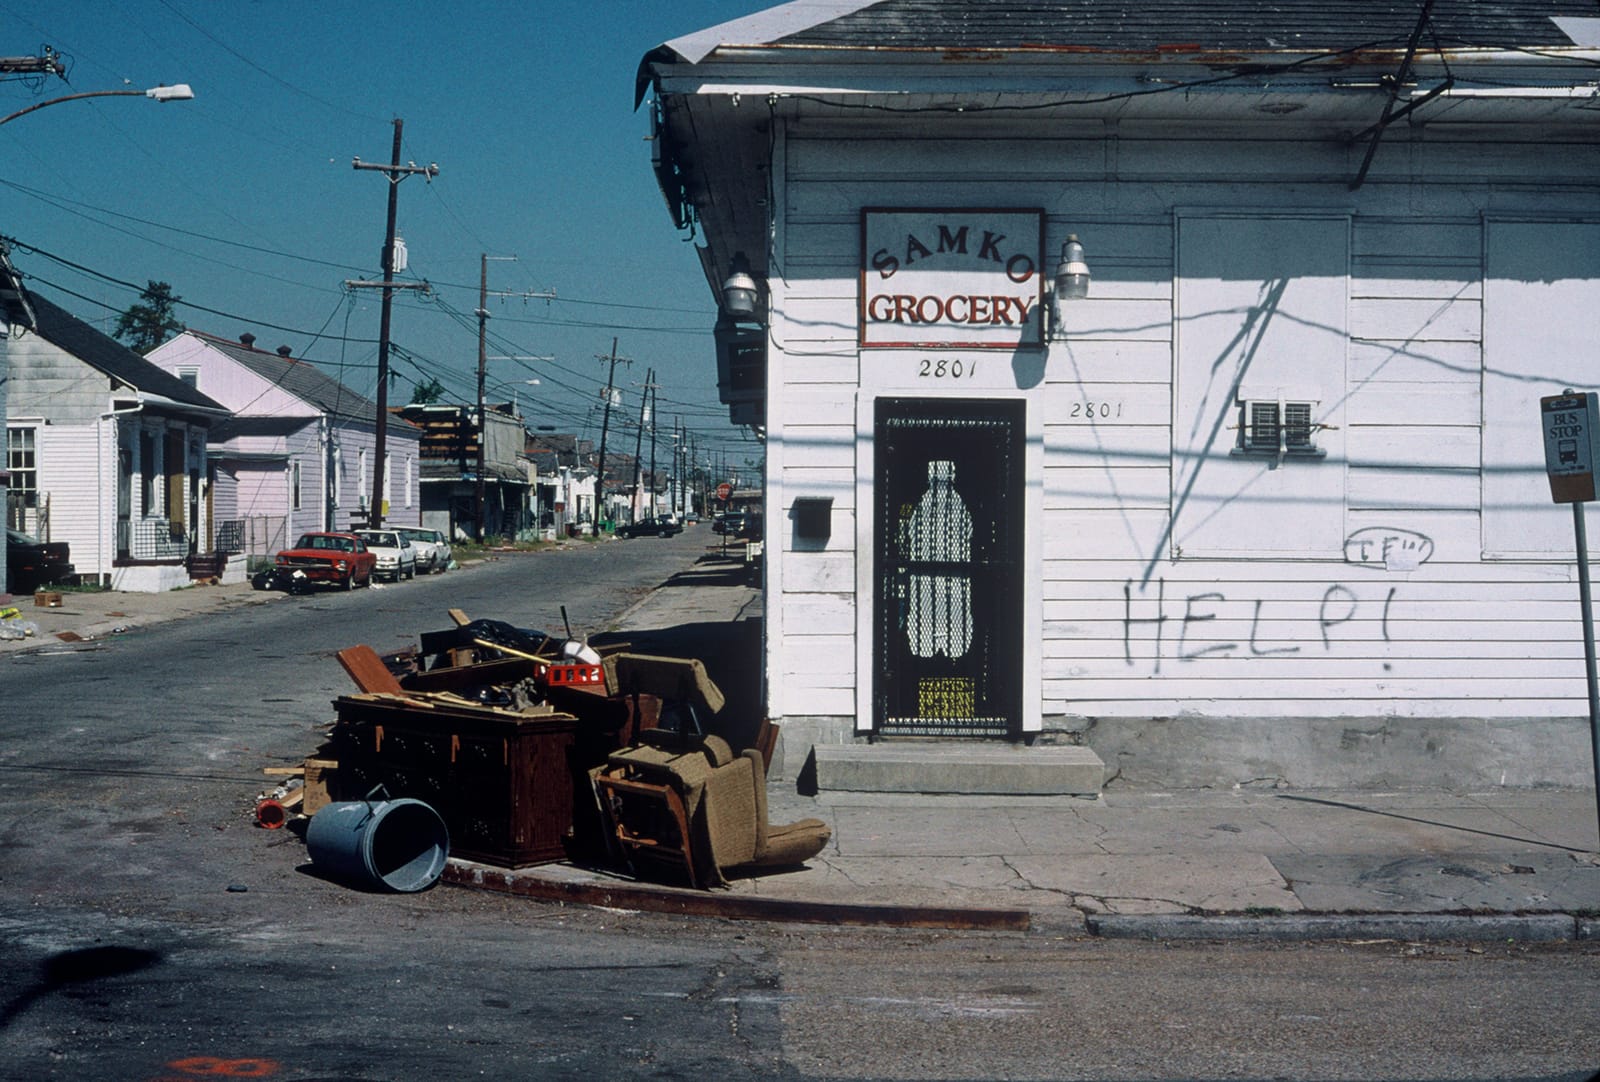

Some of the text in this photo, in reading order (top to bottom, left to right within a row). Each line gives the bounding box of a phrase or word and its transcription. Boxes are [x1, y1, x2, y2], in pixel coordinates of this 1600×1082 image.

[872, 225, 1035, 283] SAMKO
[868, 294, 1036, 325] GROCERY
[919, 359, 977, 378] 2801
[1070, 402, 1122, 418] 2801
[1553, 413, 1578, 426] BUS
[1550, 424, 1583, 439] STOP
[1123, 576, 1396, 674] HELP!
